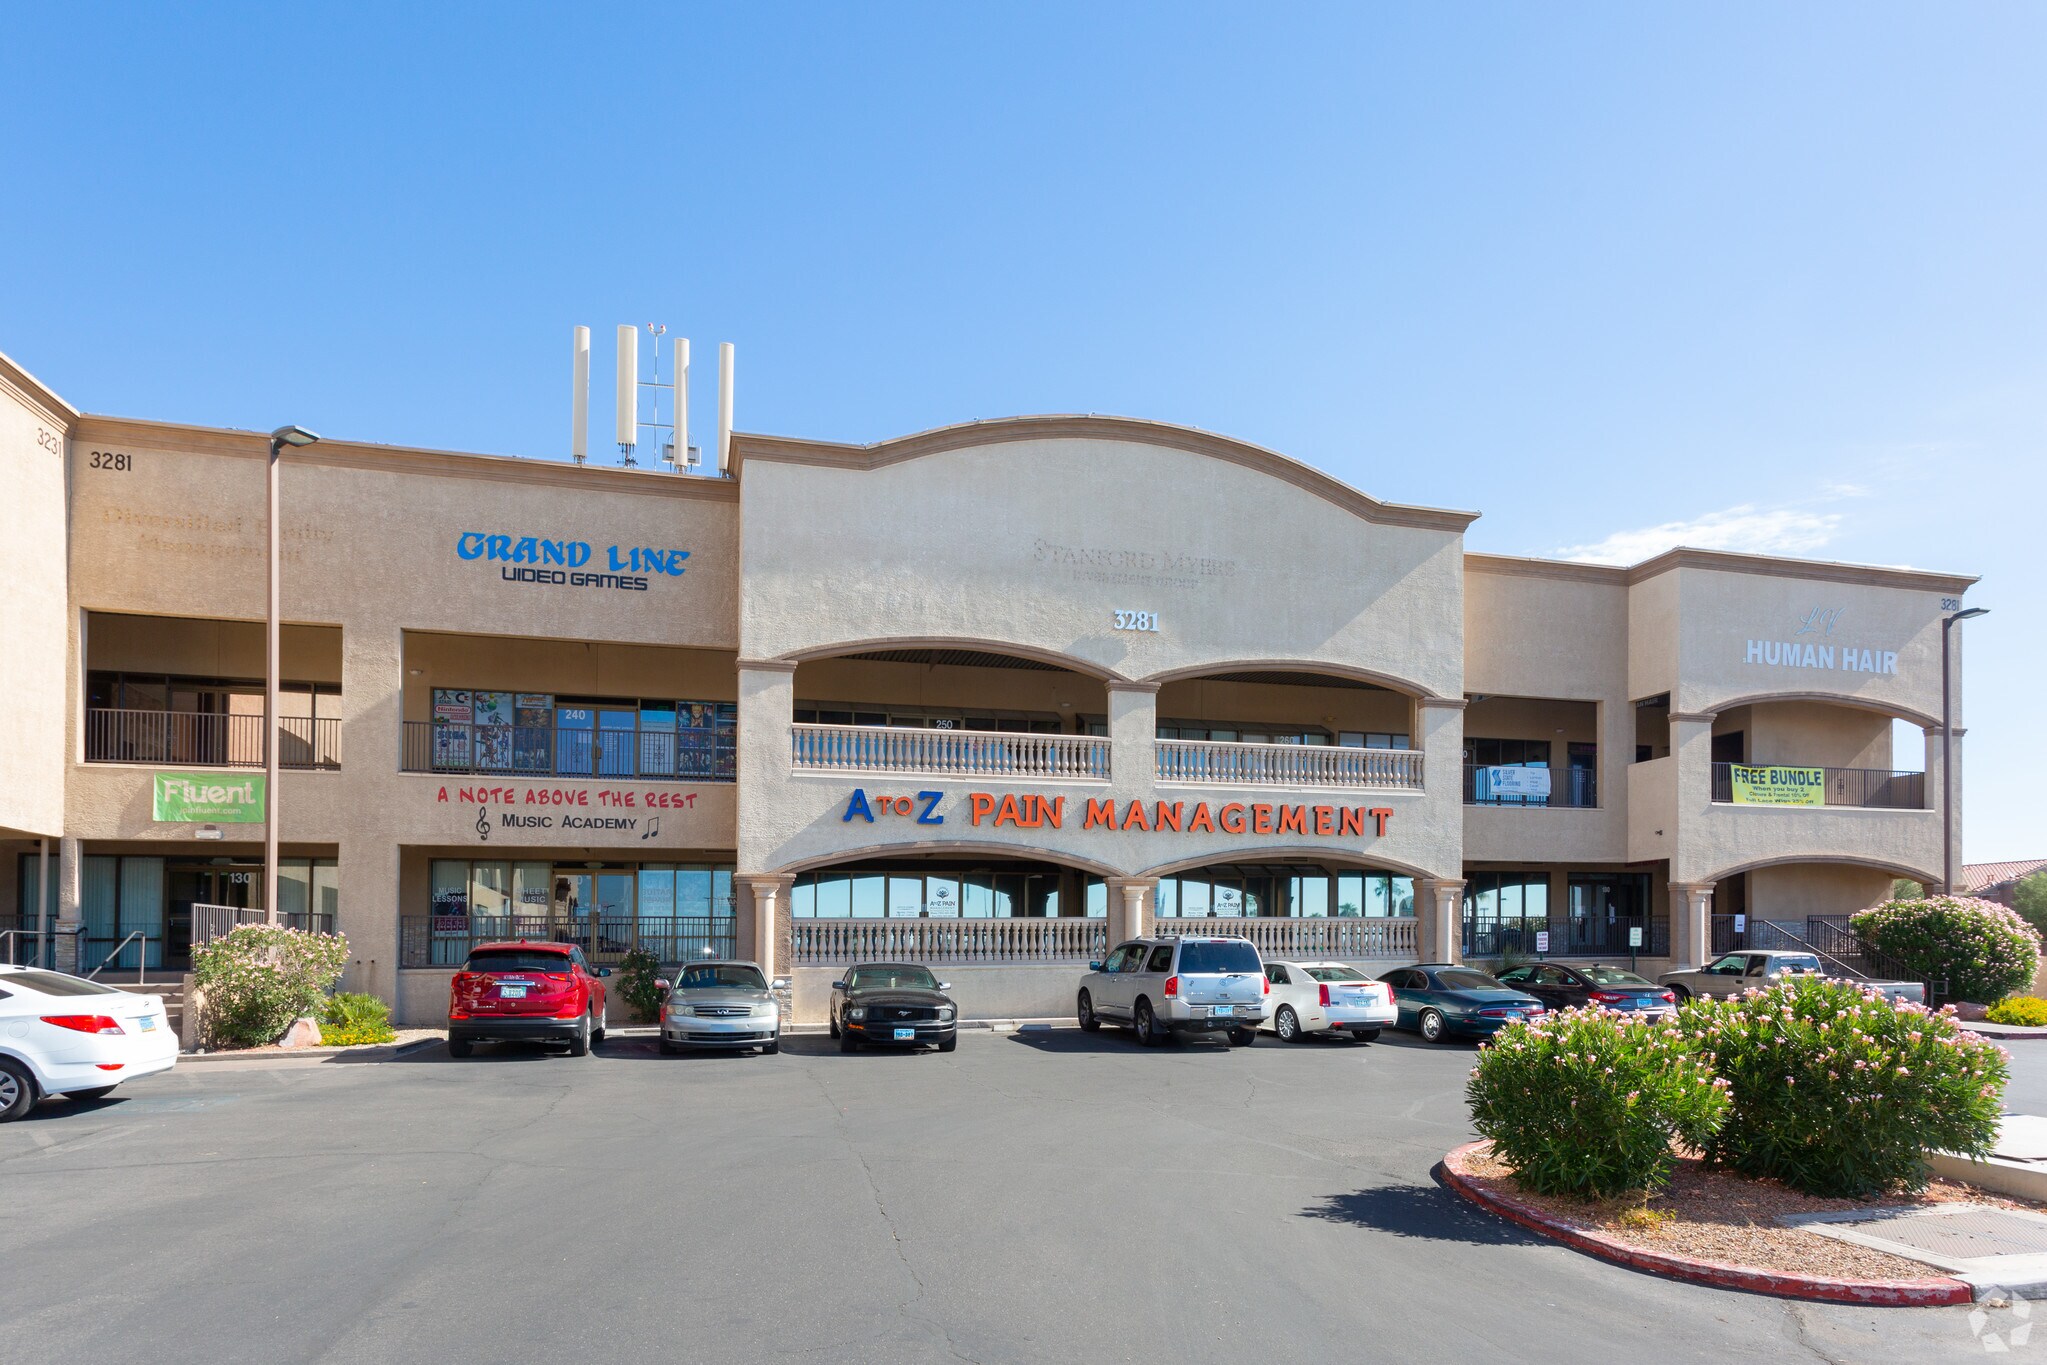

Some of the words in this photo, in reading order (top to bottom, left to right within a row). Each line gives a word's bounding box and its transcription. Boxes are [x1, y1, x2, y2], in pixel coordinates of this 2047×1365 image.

[37, 428, 61, 458] 3231
[89, 451, 131, 472] 3281
[457, 532, 592, 568] GRAND
[607, 545, 690, 577] LINE
[502, 566, 566, 585] VIDEO
[570, 572, 648, 591] GAMES
[1941, 598, 1960, 612] 3281
[1113, 609, 1159, 632] 3281
[1746, 639, 1834, 669] HUMAN
[1841, 647, 1898, 675] HAIR
[565, 709, 586, 720] 240
[936, 719, 953, 730] 250
[1280, 736, 1294, 744] 260
[1734, 768, 1766, 785] FREE
[1770, 769, 1822, 787] BUNDLE
[165, 780, 257, 804] Fluent
[437, 786, 449, 803] A
[459, 787, 515, 804] NOTE
[525, 789, 589, 806] ABOVE
[599, 790, 635, 808] THE
[645, 792, 698, 809] REST
[969, 792, 1065, 828] PAIN
[1083, 798, 1394, 837] MANAGEMENT
[229, 872, 251, 883] 130
[432, 895, 468, 903] LESSONS
